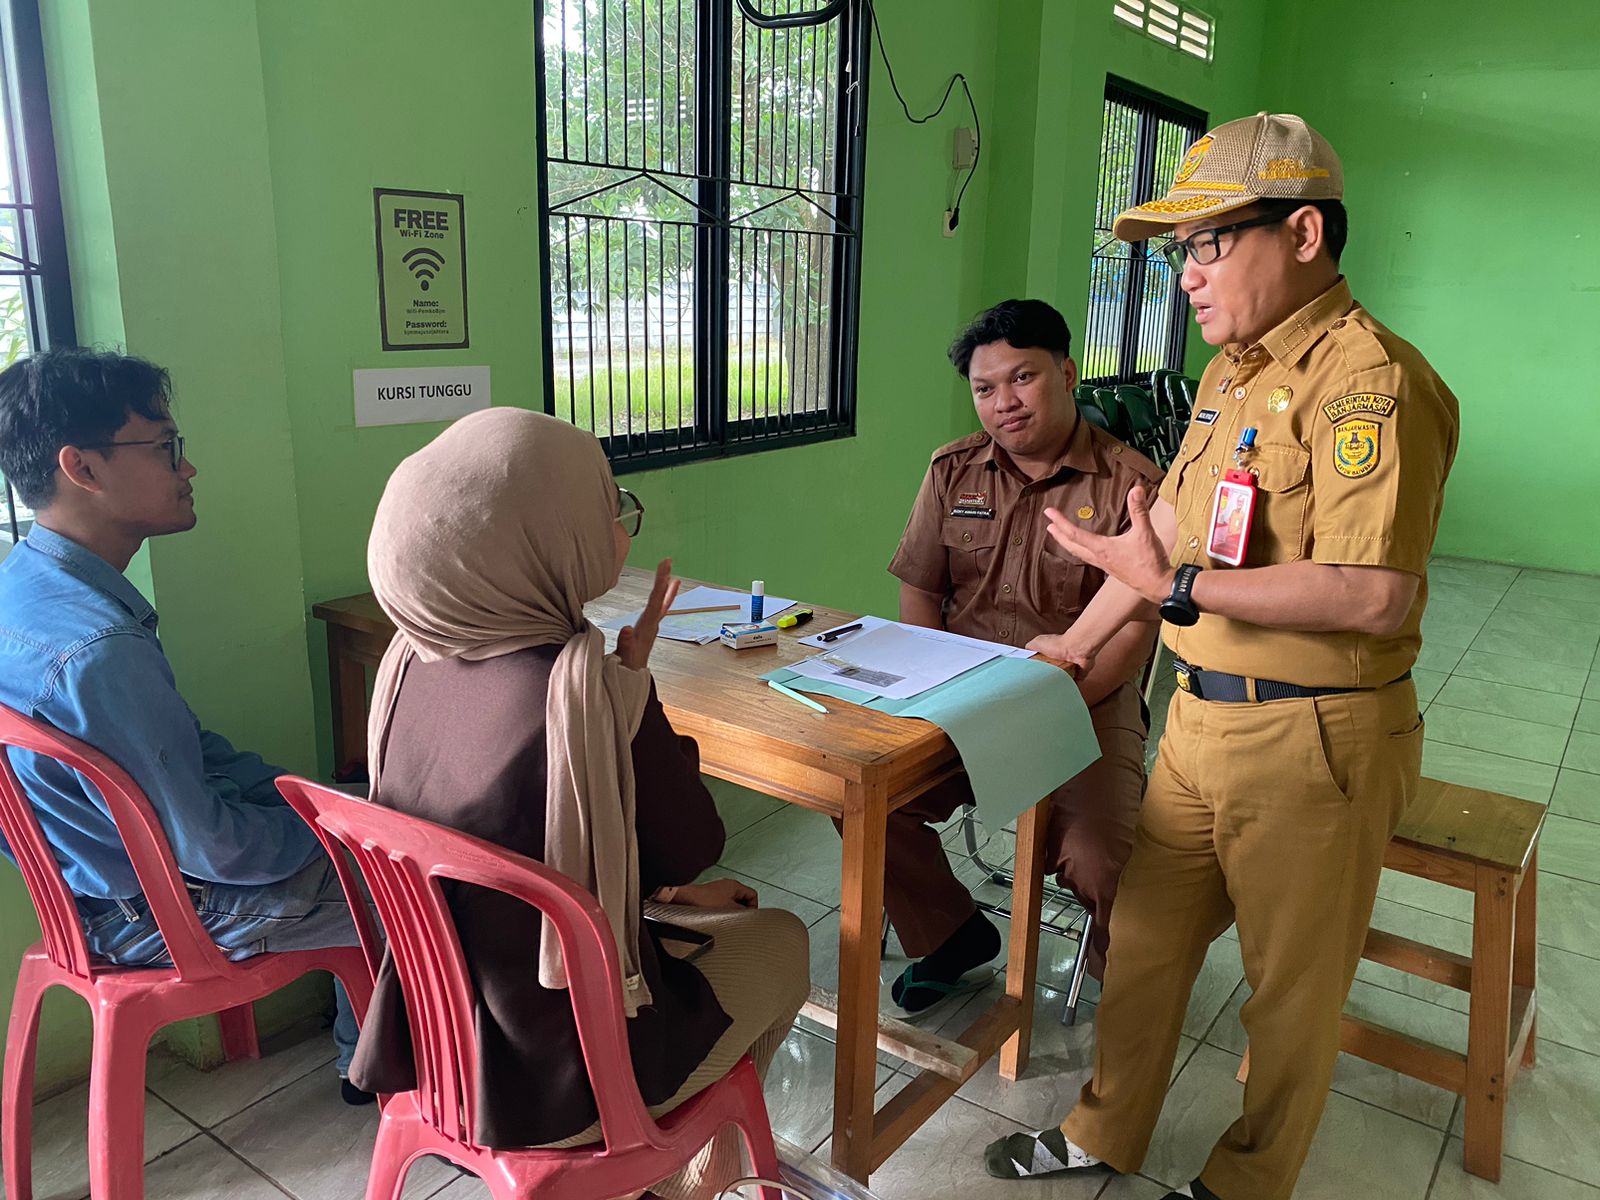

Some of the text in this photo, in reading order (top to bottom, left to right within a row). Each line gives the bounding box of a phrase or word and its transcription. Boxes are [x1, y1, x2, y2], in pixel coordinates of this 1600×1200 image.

[393, 208, 449, 231] FREE
[399, 229, 445, 239] Wi-Fi Zone
[412, 299, 439, 307] Name:
[405, 319, 447, 328] Password:
[377, 383, 472, 401] KURSI TUNGGU
[1327, 395, 1391, 412] PEMERINTAH KOTA
[1332, 403, 1388, 418] BANJARMASIN
[1337, 424, 1376, 433] BANJARMASIN
